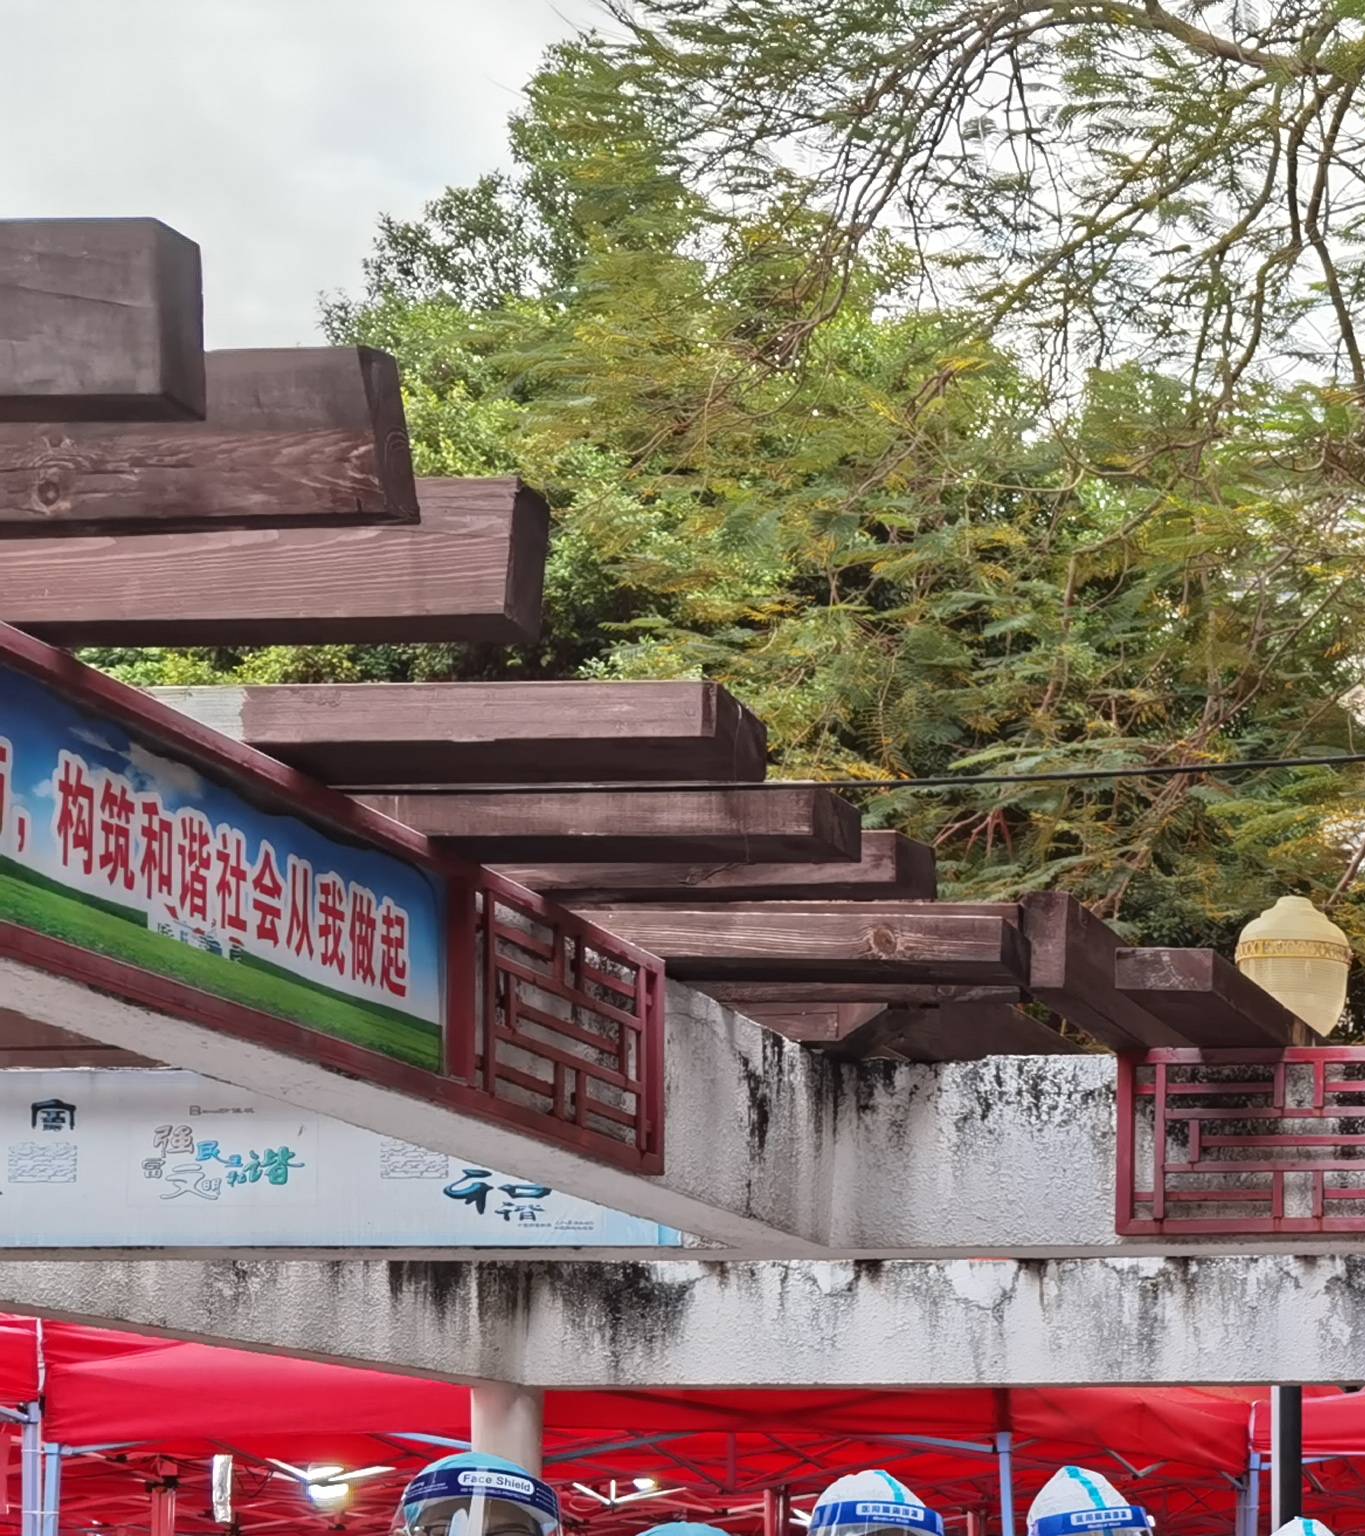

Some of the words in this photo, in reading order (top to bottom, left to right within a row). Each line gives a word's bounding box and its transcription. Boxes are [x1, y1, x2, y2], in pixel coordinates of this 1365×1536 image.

[0, 746, 407, 998] ，构筑和谐社会从我做起
[463, 1473, 493, 1484] Face
[496, 1476, 531, 1493] Shield
